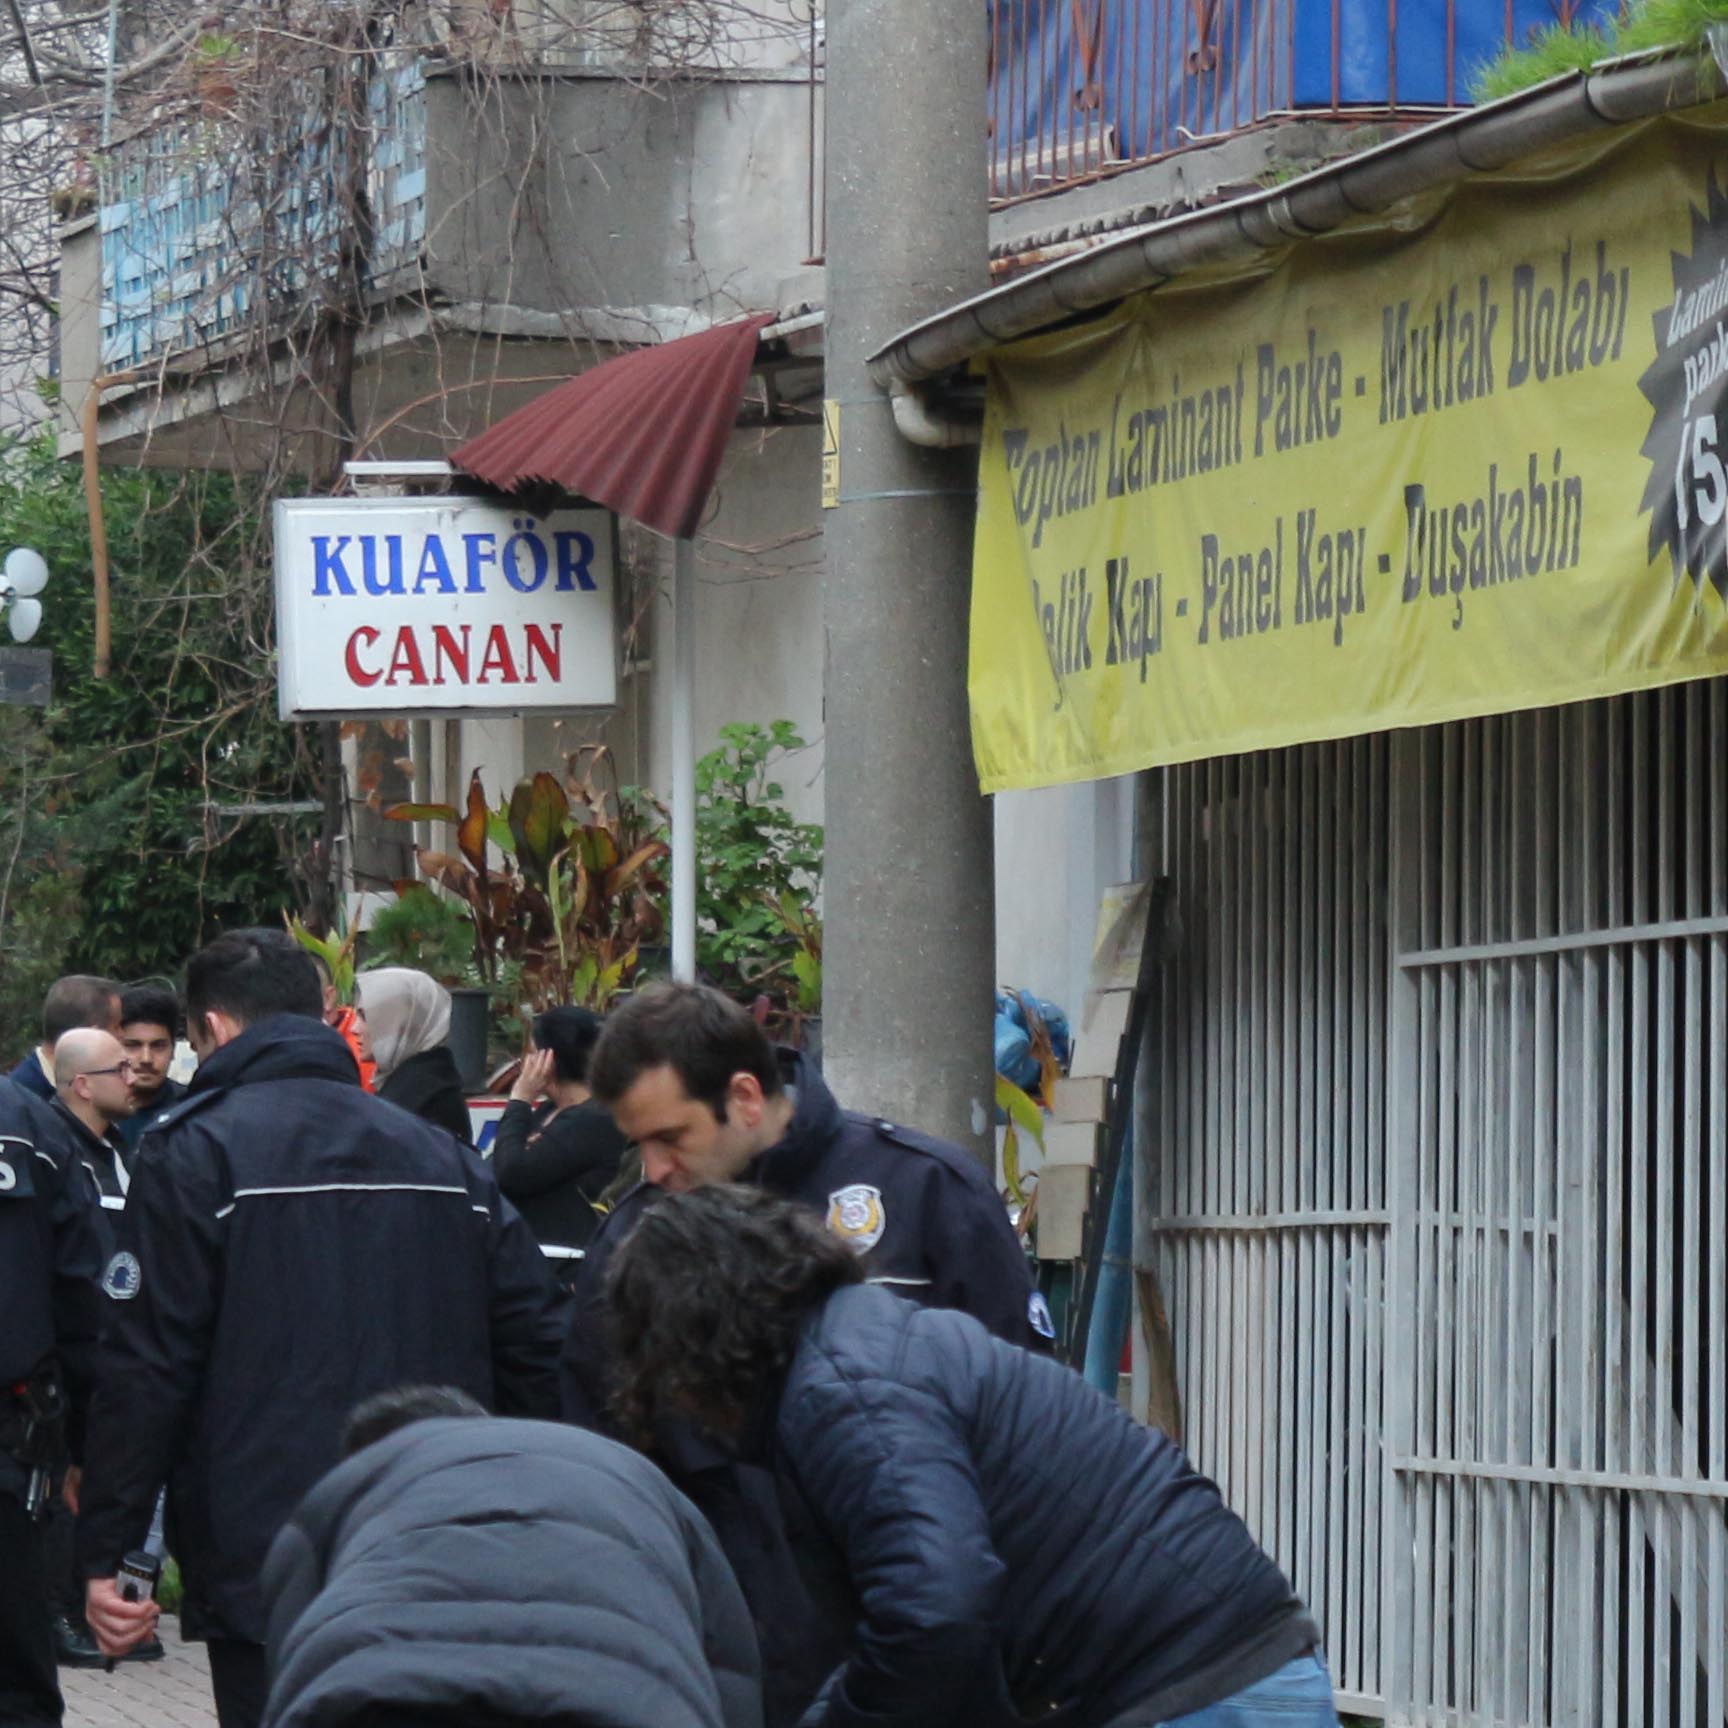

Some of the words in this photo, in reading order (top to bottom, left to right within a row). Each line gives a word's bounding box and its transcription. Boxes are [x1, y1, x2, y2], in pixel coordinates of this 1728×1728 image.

[1107, 362, 1245, 499] Laminant
[1255, 330, 1341, 458] Parke
[1379, 274, 1499, 424] Mutfak
[1507, 238, 1630, 389] Dolabı
[311, 518, 597, 596] KUAFÖR
[1106, 556, 1163, 683] Kapı
[1198, 516, 1283, 645] Panel
[1295, 507, 1366, 645] Kapı
[1402, 447, 1583, 630] Duşakabin
[344, 623, 563, 687] CANAN
